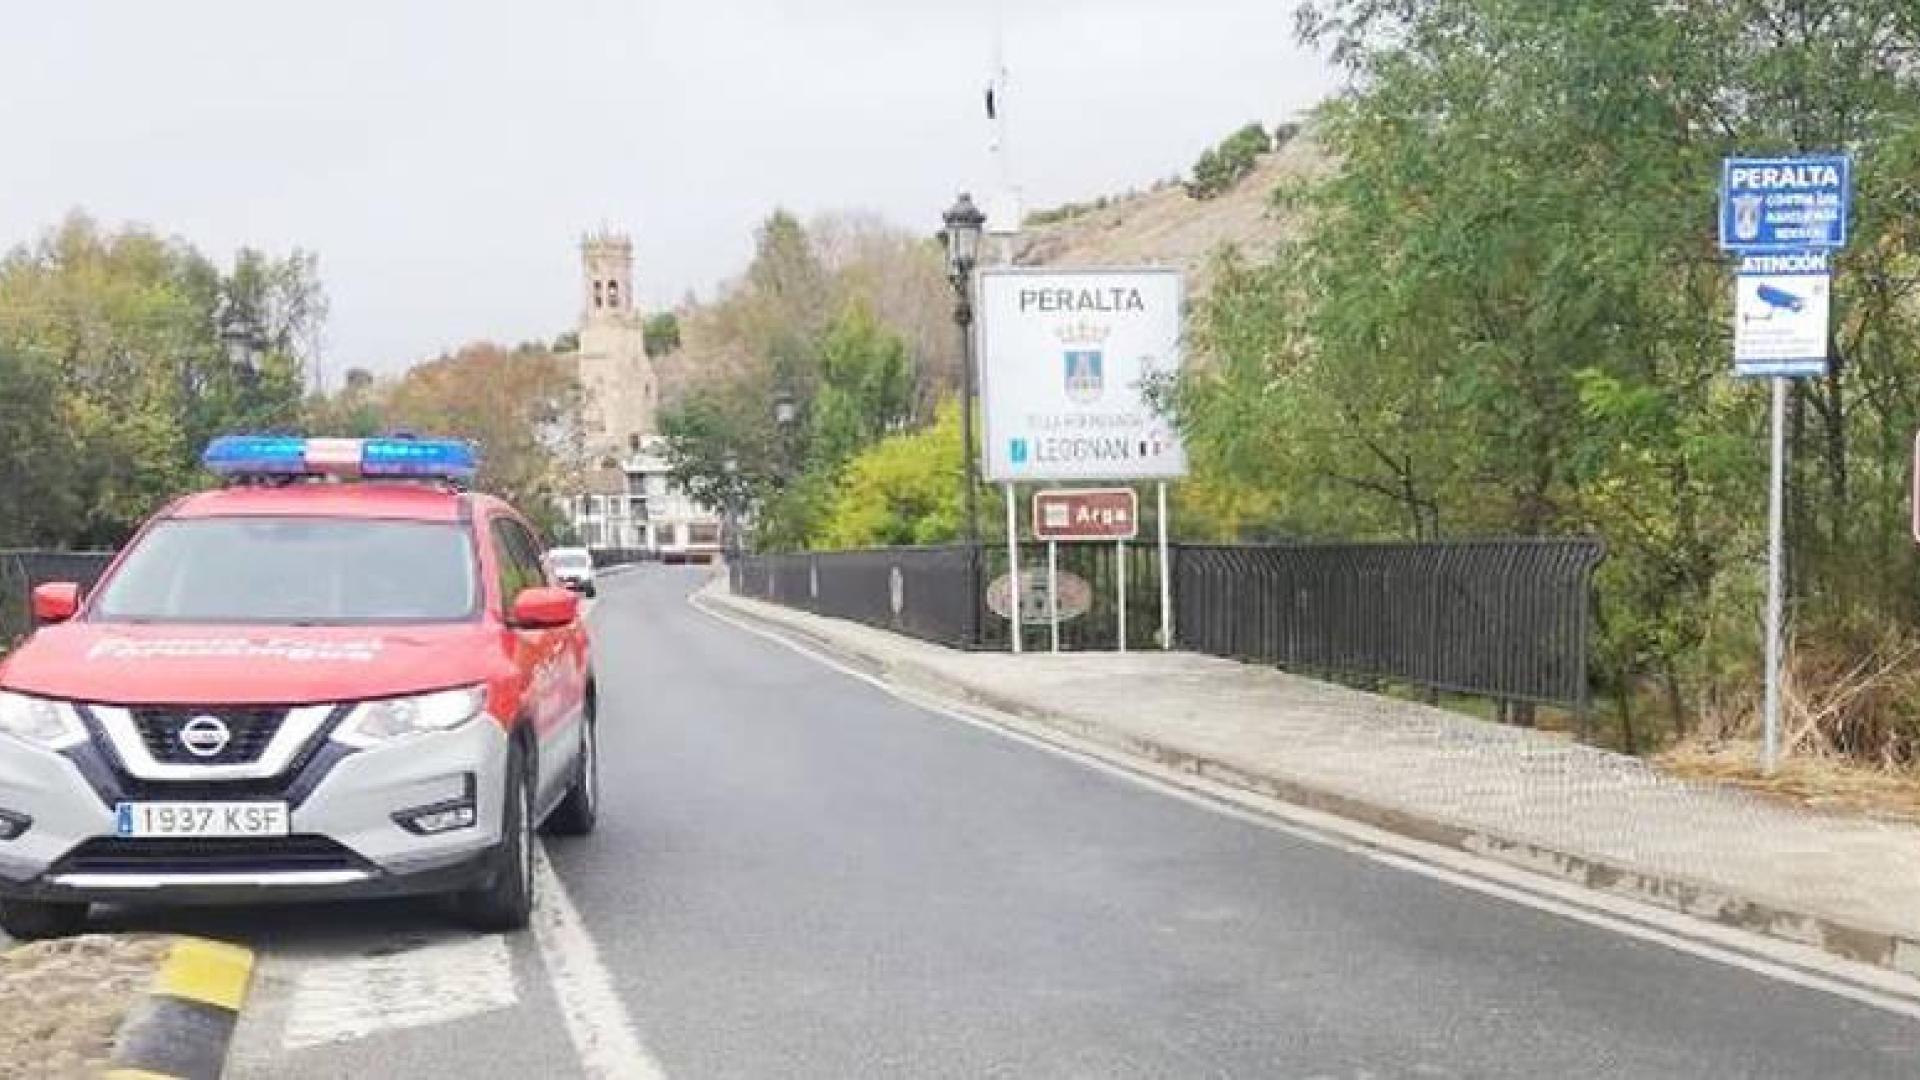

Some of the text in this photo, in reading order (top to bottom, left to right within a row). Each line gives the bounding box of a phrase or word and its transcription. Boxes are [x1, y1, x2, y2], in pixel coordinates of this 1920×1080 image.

[1732, 165, 1840, 189] PERALTA
[1020, 287, 1144, 313] PERALTA
[144, 807, 280, 832] 1937 KSF
